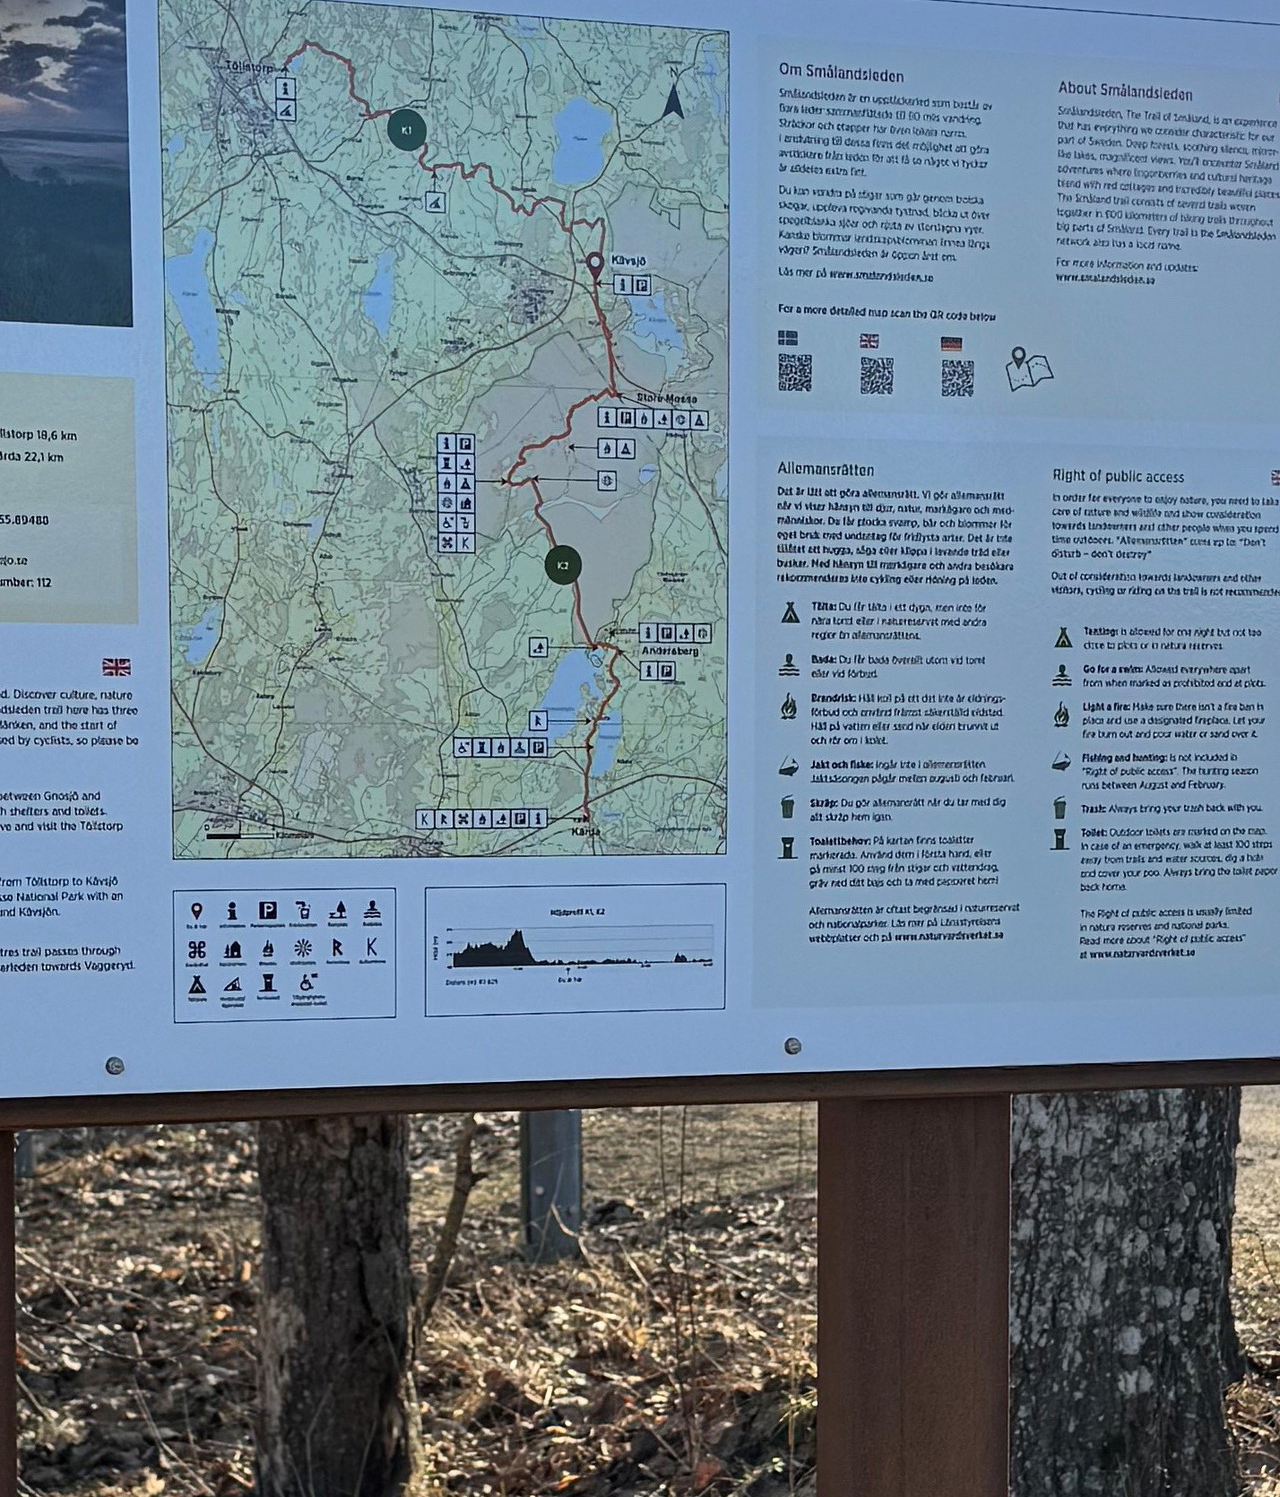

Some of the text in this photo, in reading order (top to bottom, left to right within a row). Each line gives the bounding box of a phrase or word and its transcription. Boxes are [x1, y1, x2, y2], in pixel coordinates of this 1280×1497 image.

[225, 58, 277, 76] Töllstorp
[777, 61, 905, 84] Om Smålandsleden
[1057, 79, 1194, 103] About Smålandsleden
[609, 253, 647, 269] Kävsjö
[665, 391, 699, 407] Mosse
[59, 429, 78, 442] km
[46, 451, 65, 463] km
[776, 459, 875, 478] Allemansrätten
[1051, 467, 1186, 485] Right of public access
[35, 576, 52, 589] 112
[12, 687, 58, 700] Discover
[58, 689, 99, 701] culture,
[99, 689, 134, 701] nature
[64, 704, 90, 716] here
[90, 704, 110, 716] has
[110, 704, 139, 716] three
[42, 789, 80, 803] Gnosjö
[80, 789, 102, 802] and
